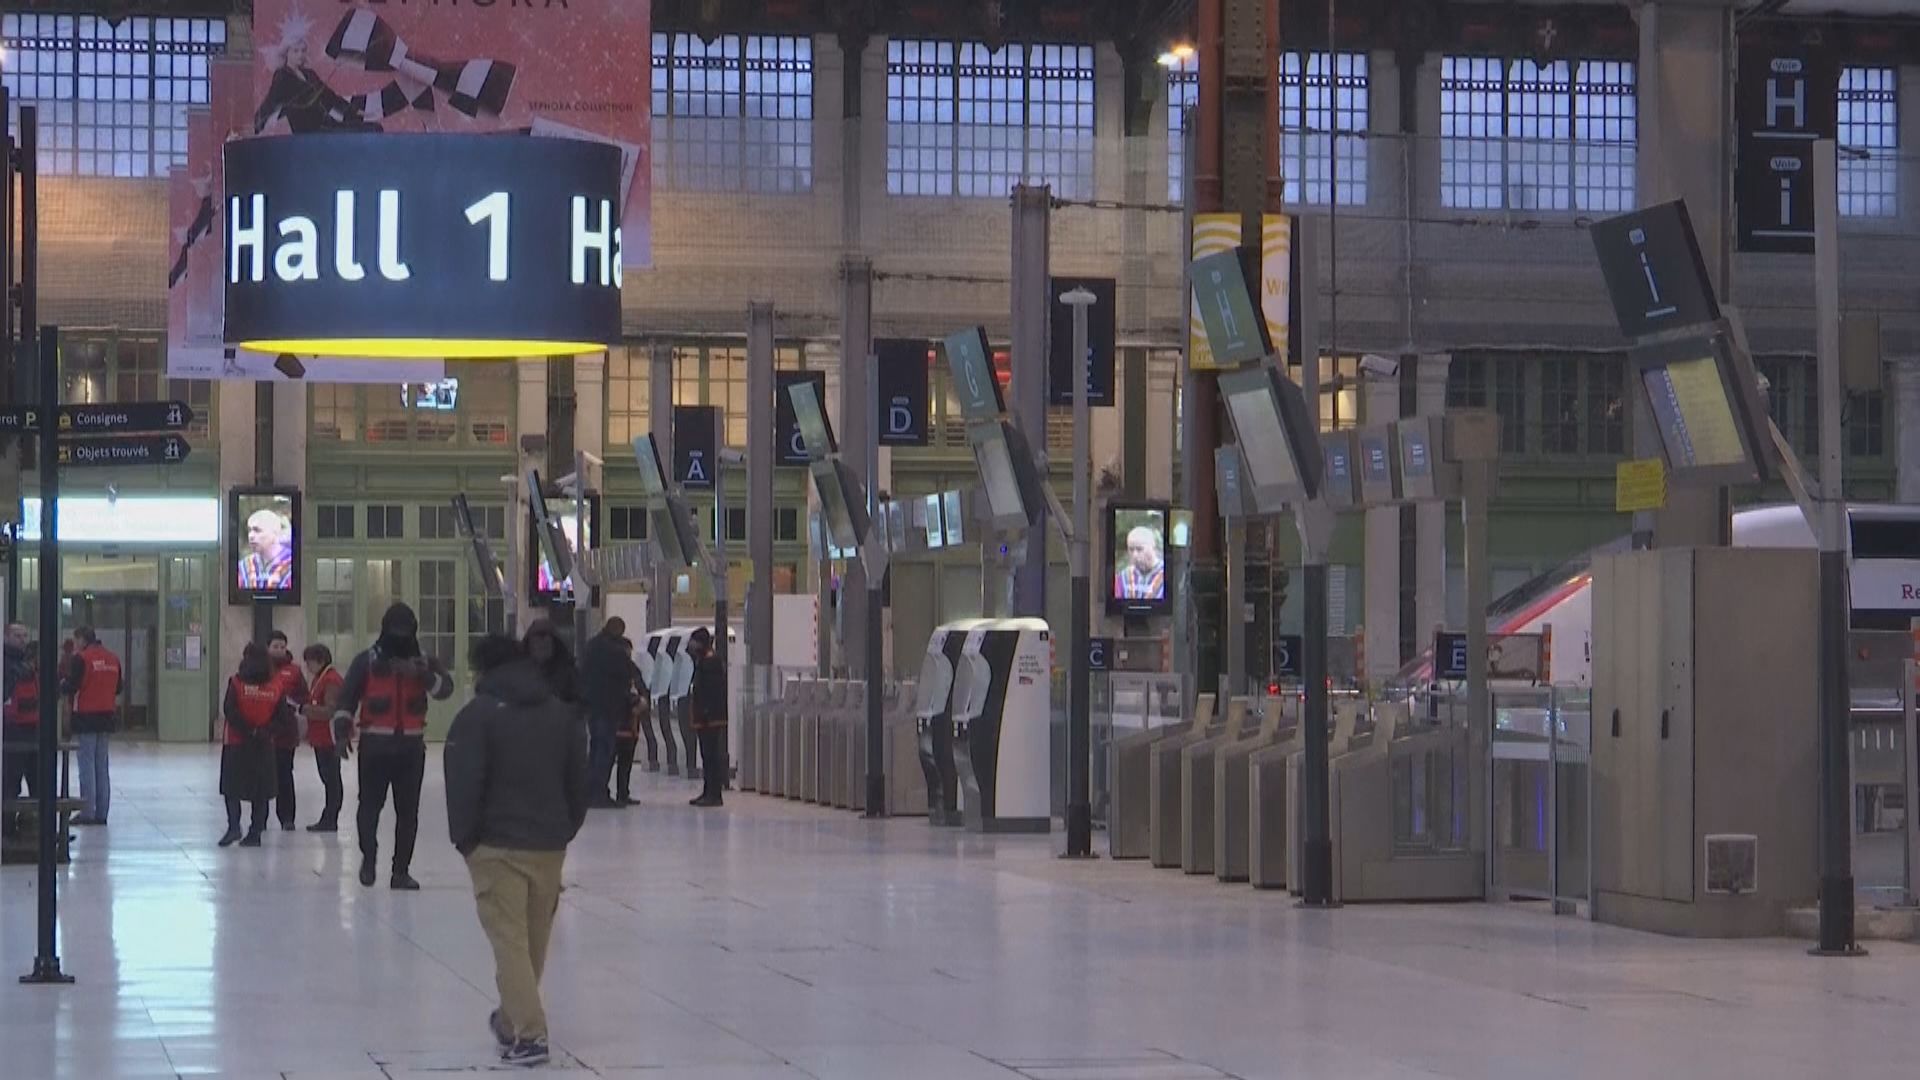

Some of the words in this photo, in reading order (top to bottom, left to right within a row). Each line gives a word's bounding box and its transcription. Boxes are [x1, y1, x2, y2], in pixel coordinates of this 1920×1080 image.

[1766, 78, 1804, 128] H
[231, 189, 410, 283] Hall
[464, 191, 509, 282] 1
[1215, 288, 1239, 341] H
[965, 360, 980, 400] G
[0, 414, 17, 425] rot
[26, 411, 37, 427] P
[77, 411, 128, 427] Consignes
[890, 407, 912, 433] D
[76, 445, 110, 461] Objets
[112, 444, 149, 458] trouvés
[687, 459, 705, 480] A
[1090, 650, 1103, 665] C
[1452, 648, 1465, 670] E
